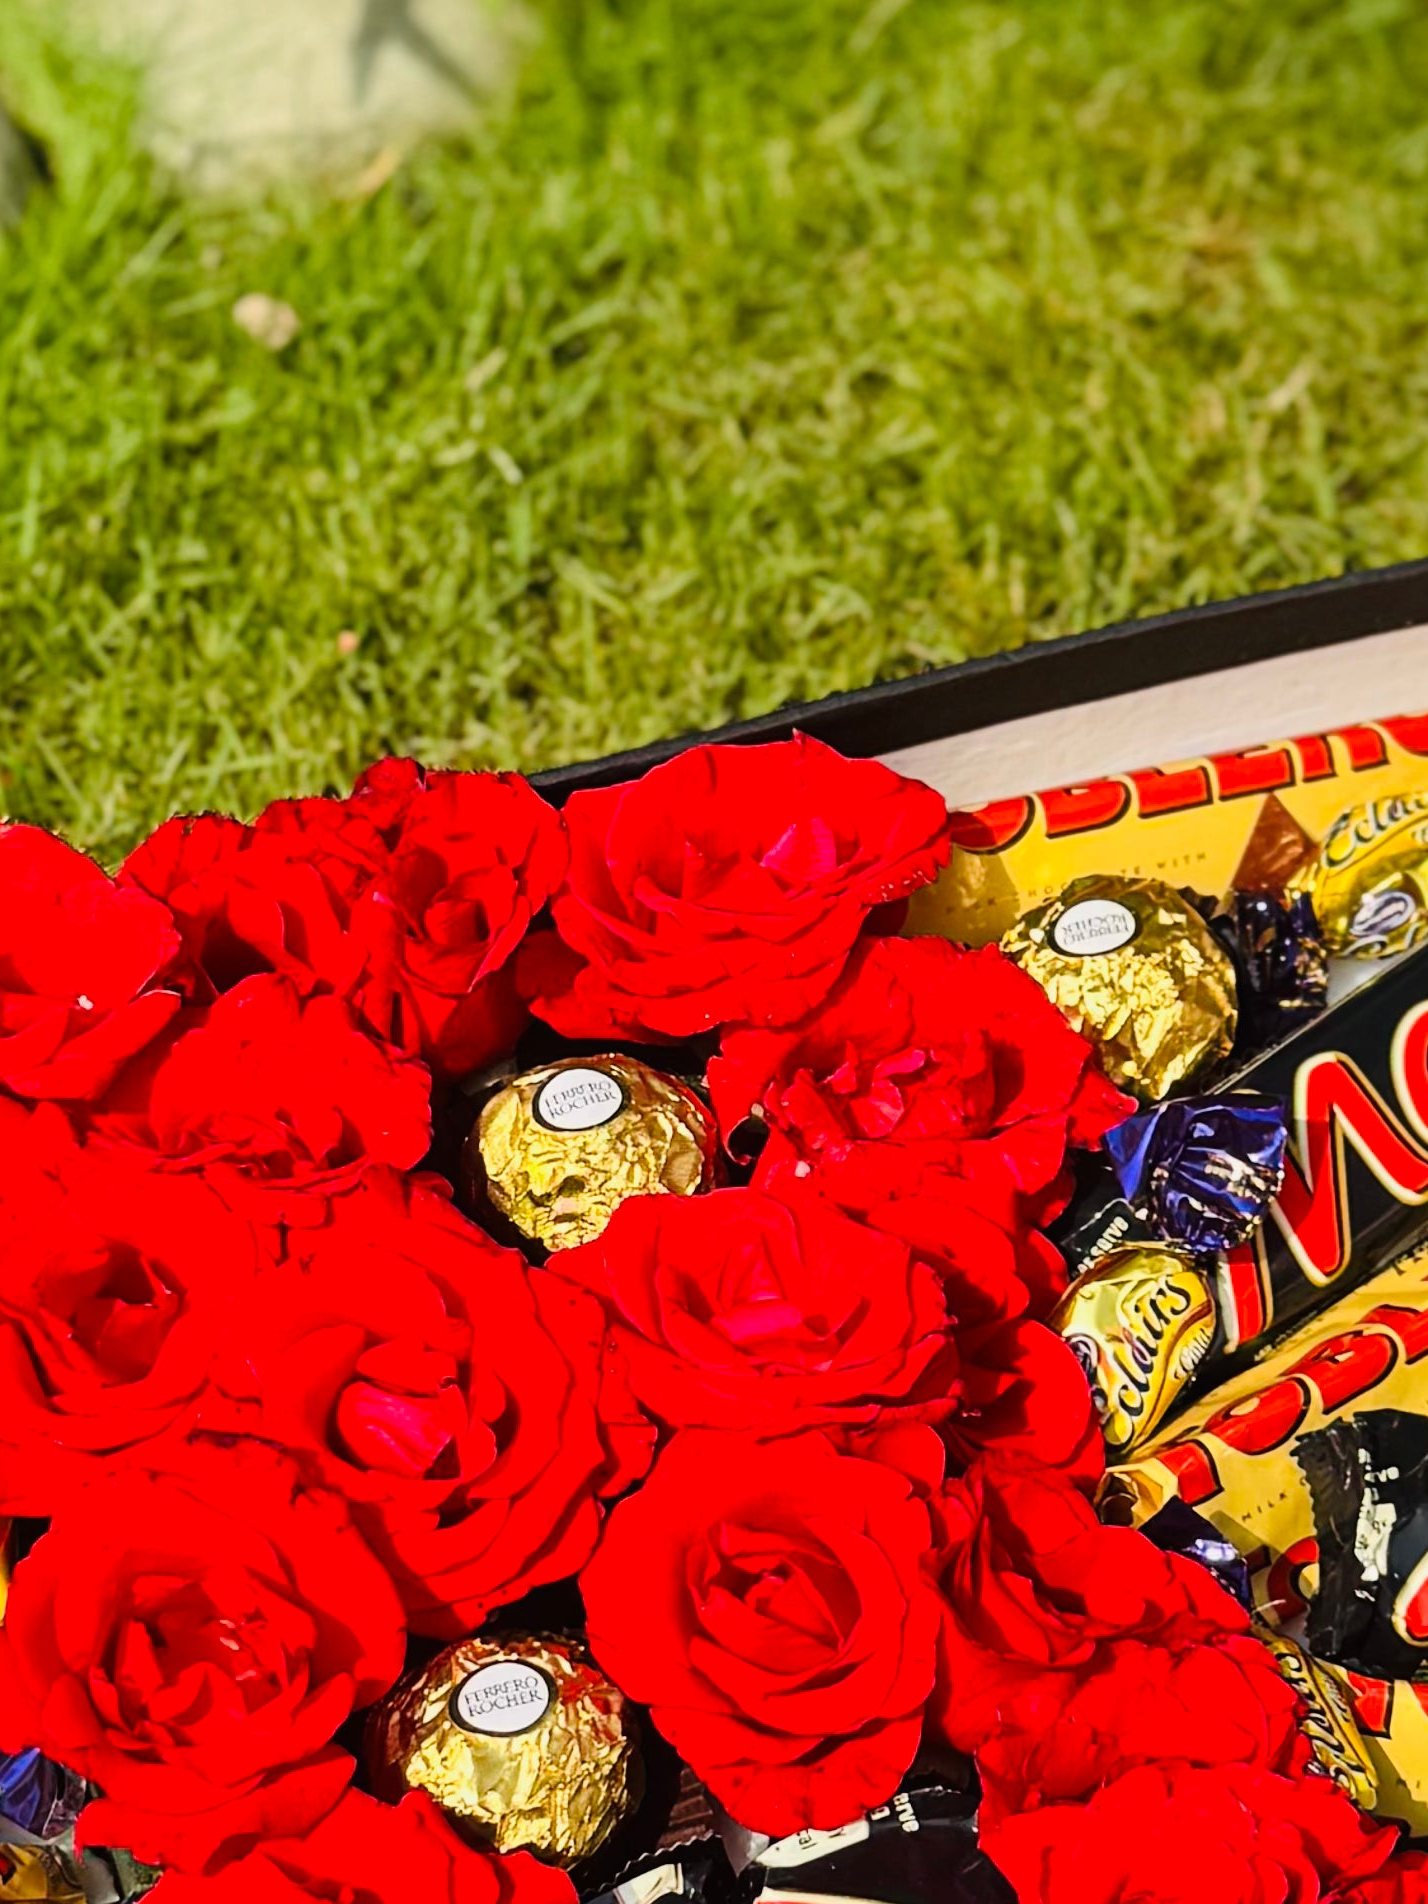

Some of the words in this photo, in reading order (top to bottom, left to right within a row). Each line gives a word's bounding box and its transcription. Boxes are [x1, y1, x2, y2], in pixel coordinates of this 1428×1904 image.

[1156, 851, 1208, 872] WITH
[1241, 1491, 1288, 1524] MILK
[468, 1689, 543, 1718] ROCHER
